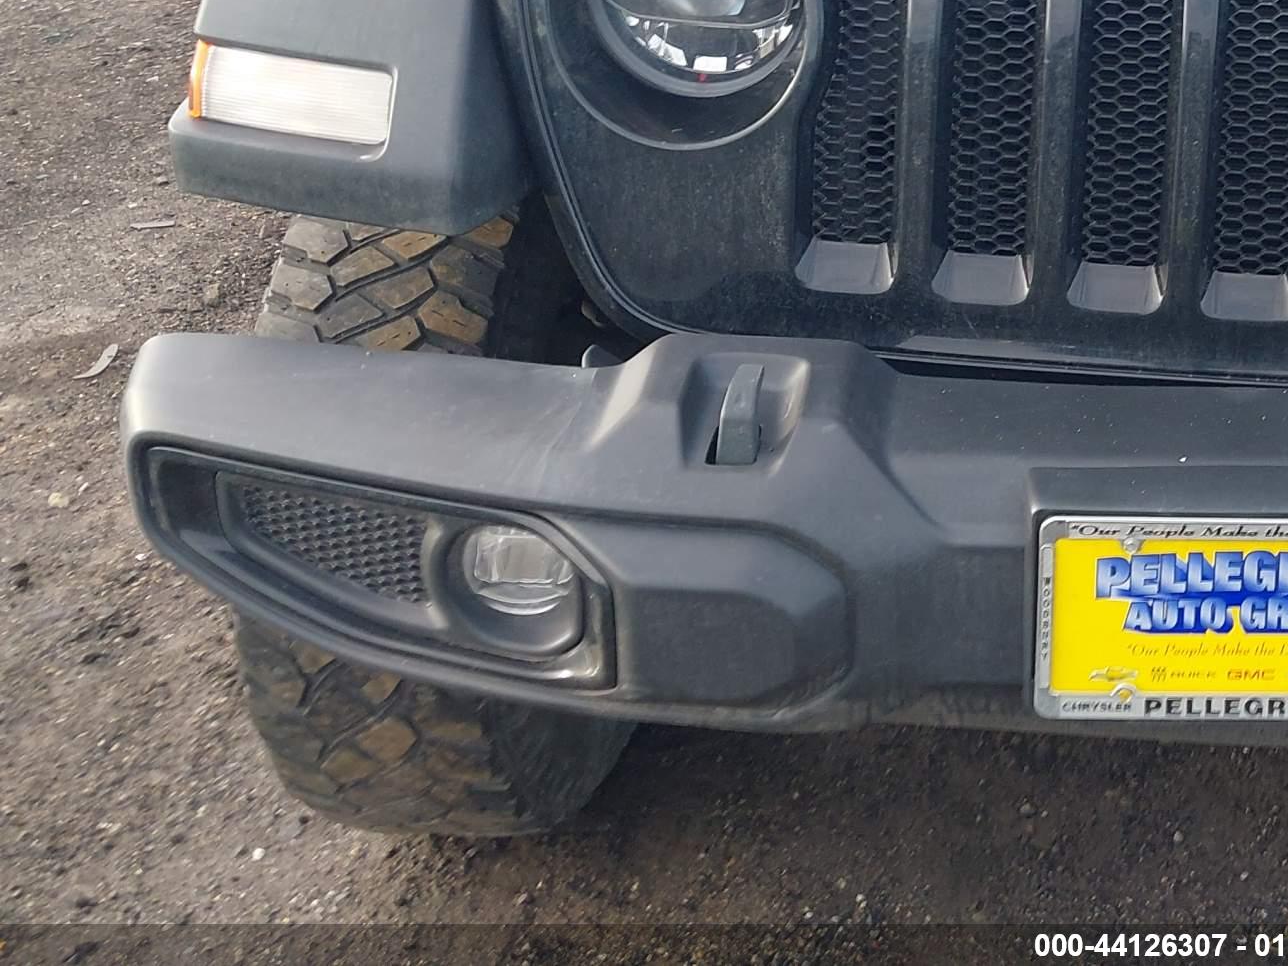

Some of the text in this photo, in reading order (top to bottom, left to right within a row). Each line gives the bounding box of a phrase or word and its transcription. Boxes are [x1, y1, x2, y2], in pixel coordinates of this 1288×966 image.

[1128, 525, 1197, 539] People
[1200, 525, 1258, 538] Make
[1124, 596, 1232, 633] AUTO
[1061, 701, 1133, 714] CHRYSLER
